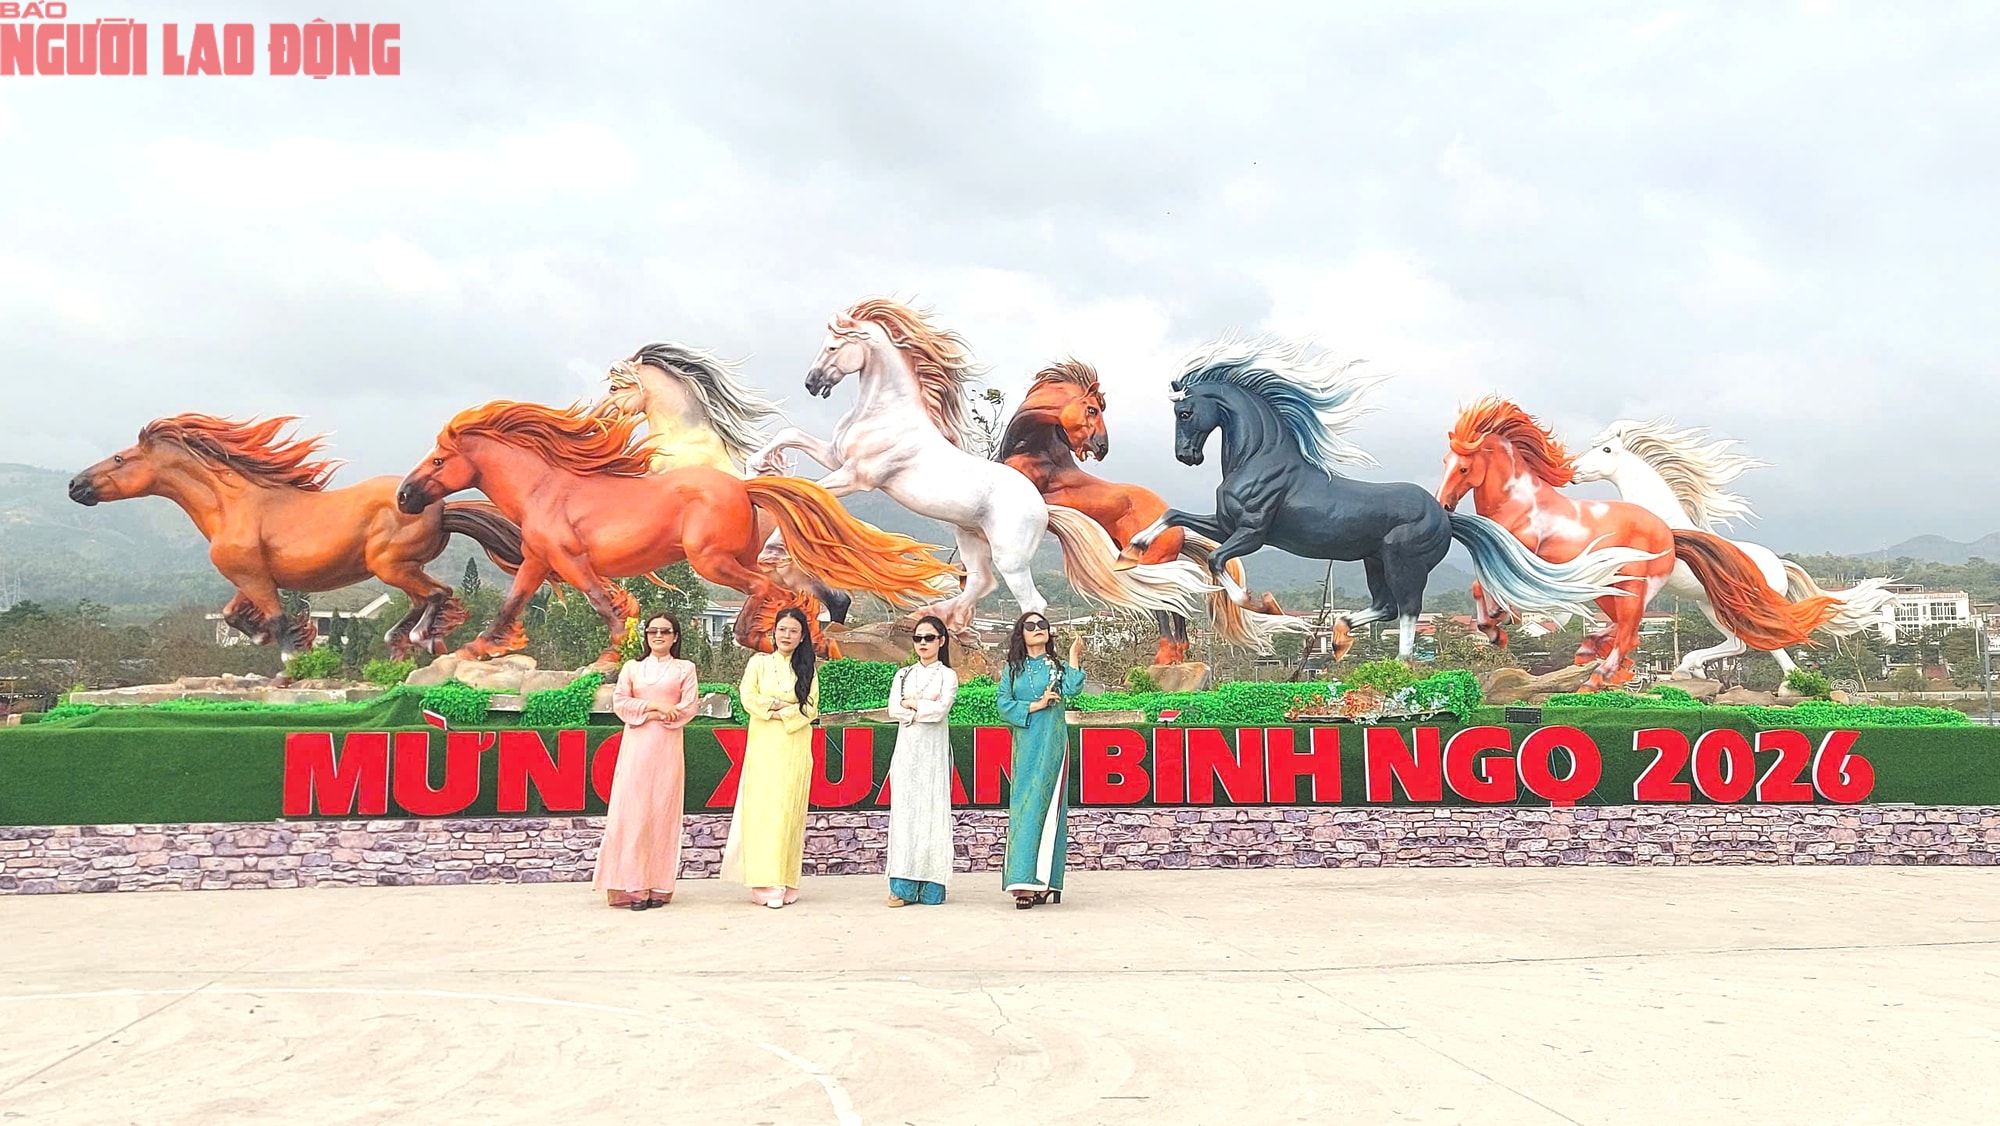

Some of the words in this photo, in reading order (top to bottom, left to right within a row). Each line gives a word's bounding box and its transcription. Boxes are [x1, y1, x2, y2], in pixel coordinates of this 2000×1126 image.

[1080, 709, 1343, 805] BÌNH
[1363, 725, 1602, 808] NGỌ
[1633, 728, 1876, 804] 2026
